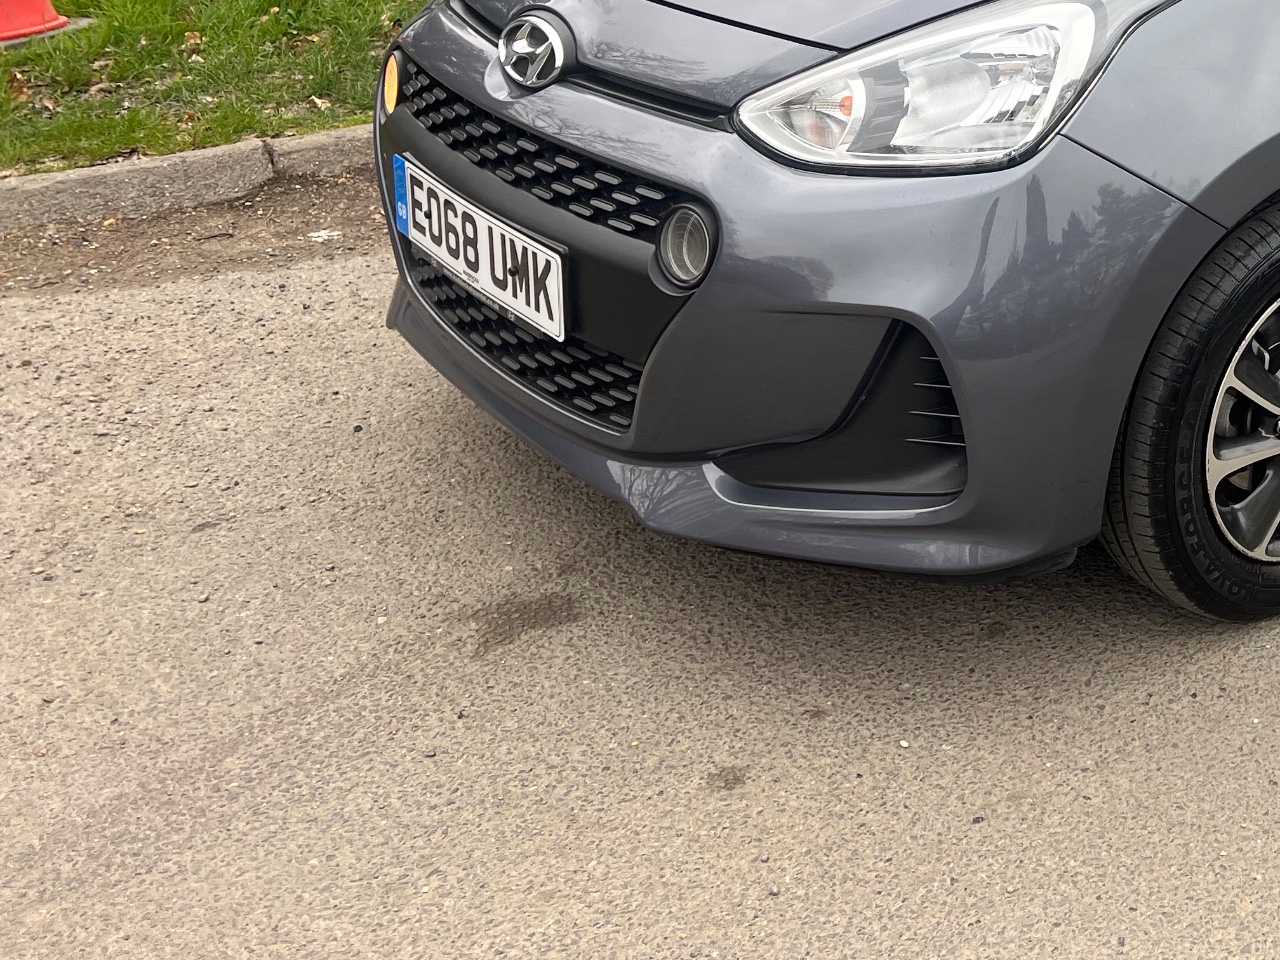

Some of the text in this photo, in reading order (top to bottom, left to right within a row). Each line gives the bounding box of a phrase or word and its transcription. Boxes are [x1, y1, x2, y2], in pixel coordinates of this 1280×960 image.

[397, 201, 407, 220] GB
[409, 173, 480, 275] EO68
[487, 225, 554, 322] UMK
